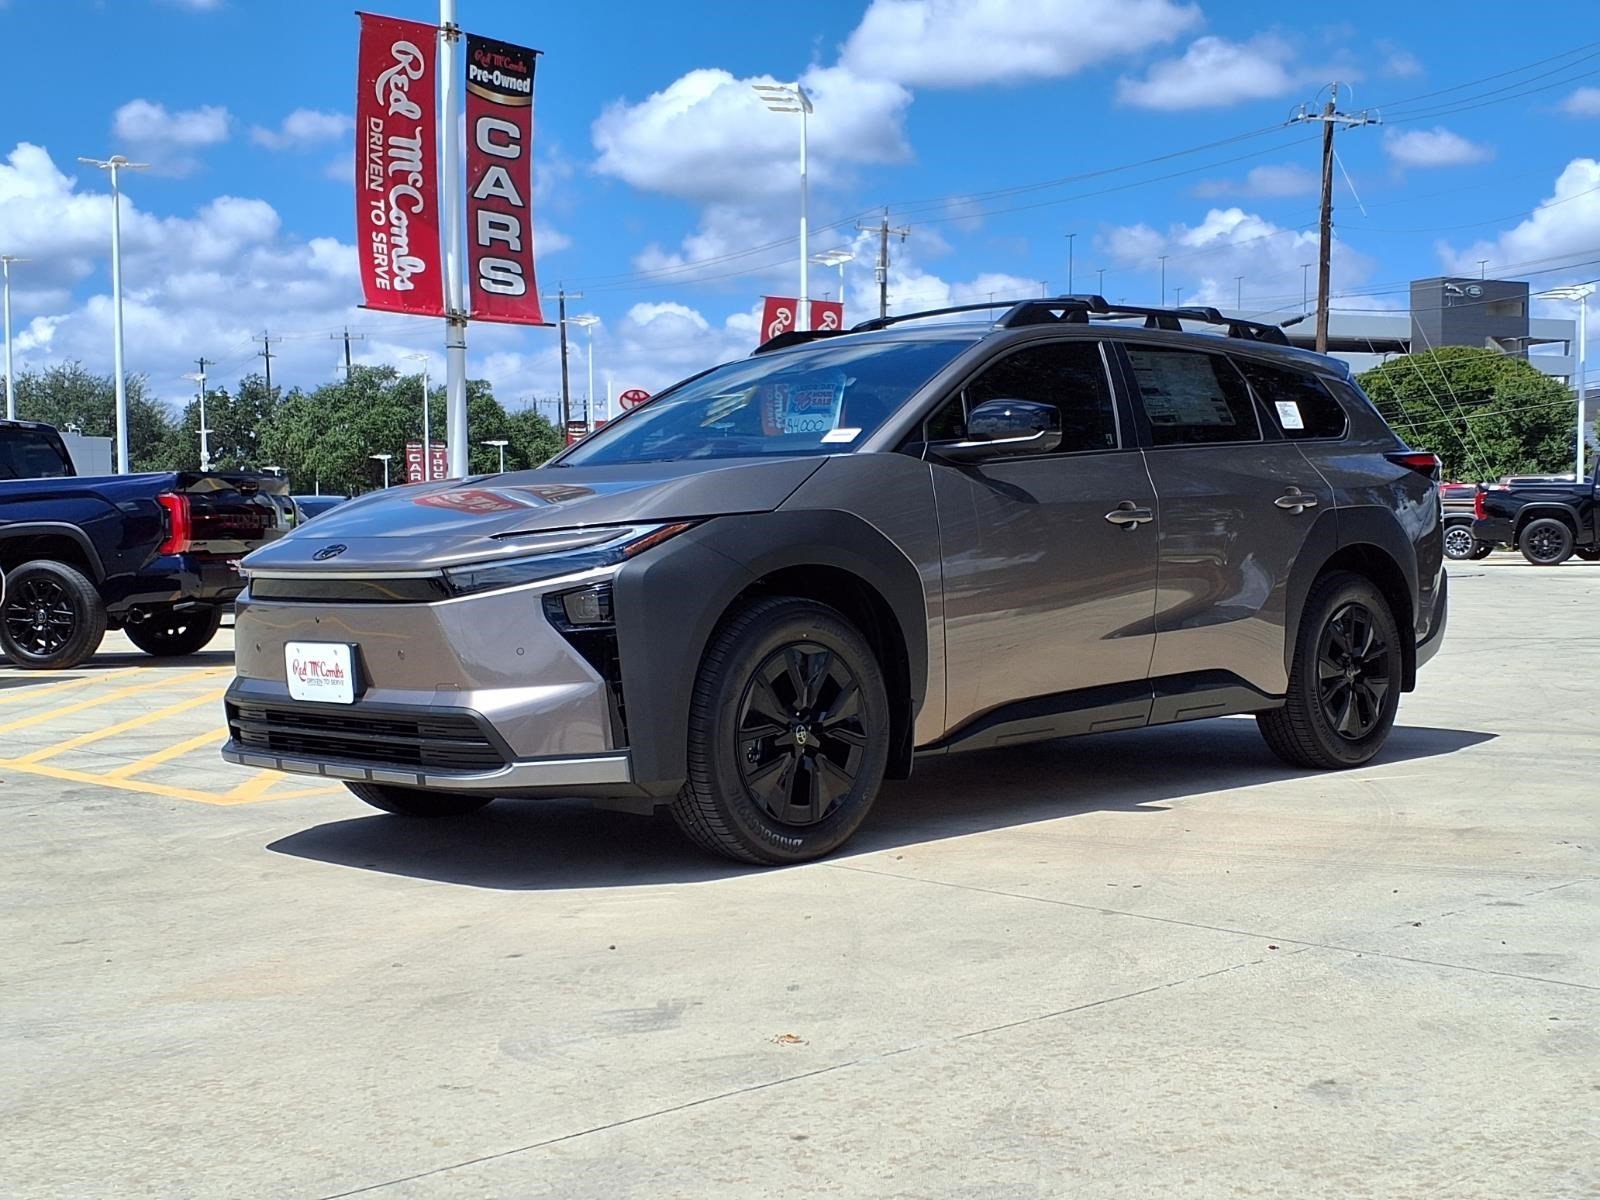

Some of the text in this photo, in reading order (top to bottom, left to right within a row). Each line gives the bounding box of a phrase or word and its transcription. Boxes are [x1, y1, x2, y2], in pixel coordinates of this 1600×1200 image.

[374, 40, 426, 291] Red McCombs
[469, 64, 531, 93] Pre-Owned
[368, 116, 391, 291] DRIVEN TO SERVE
[473, 116, 526, 297] CARS
[293, 659, 307, 682] Red
